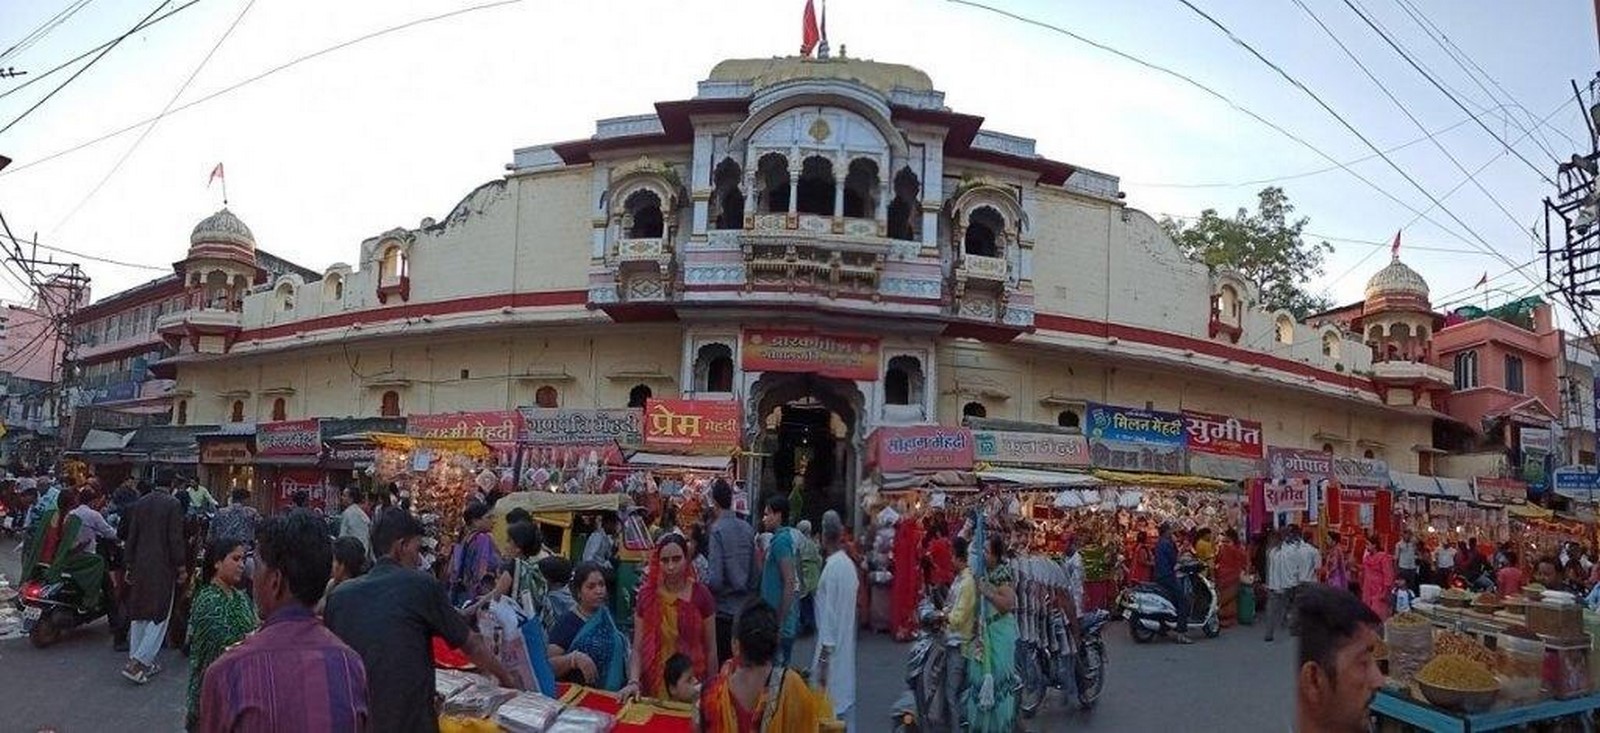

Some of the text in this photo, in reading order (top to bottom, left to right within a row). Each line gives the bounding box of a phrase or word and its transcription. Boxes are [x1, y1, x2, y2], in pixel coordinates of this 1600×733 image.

[649, 403, 704, 437] प्रेम
[1113, 412, 1150, 432] मिलन
[1185, 417, 1260, 445] सुमीत
[1285, 453, 1330, 472] गोपाल
